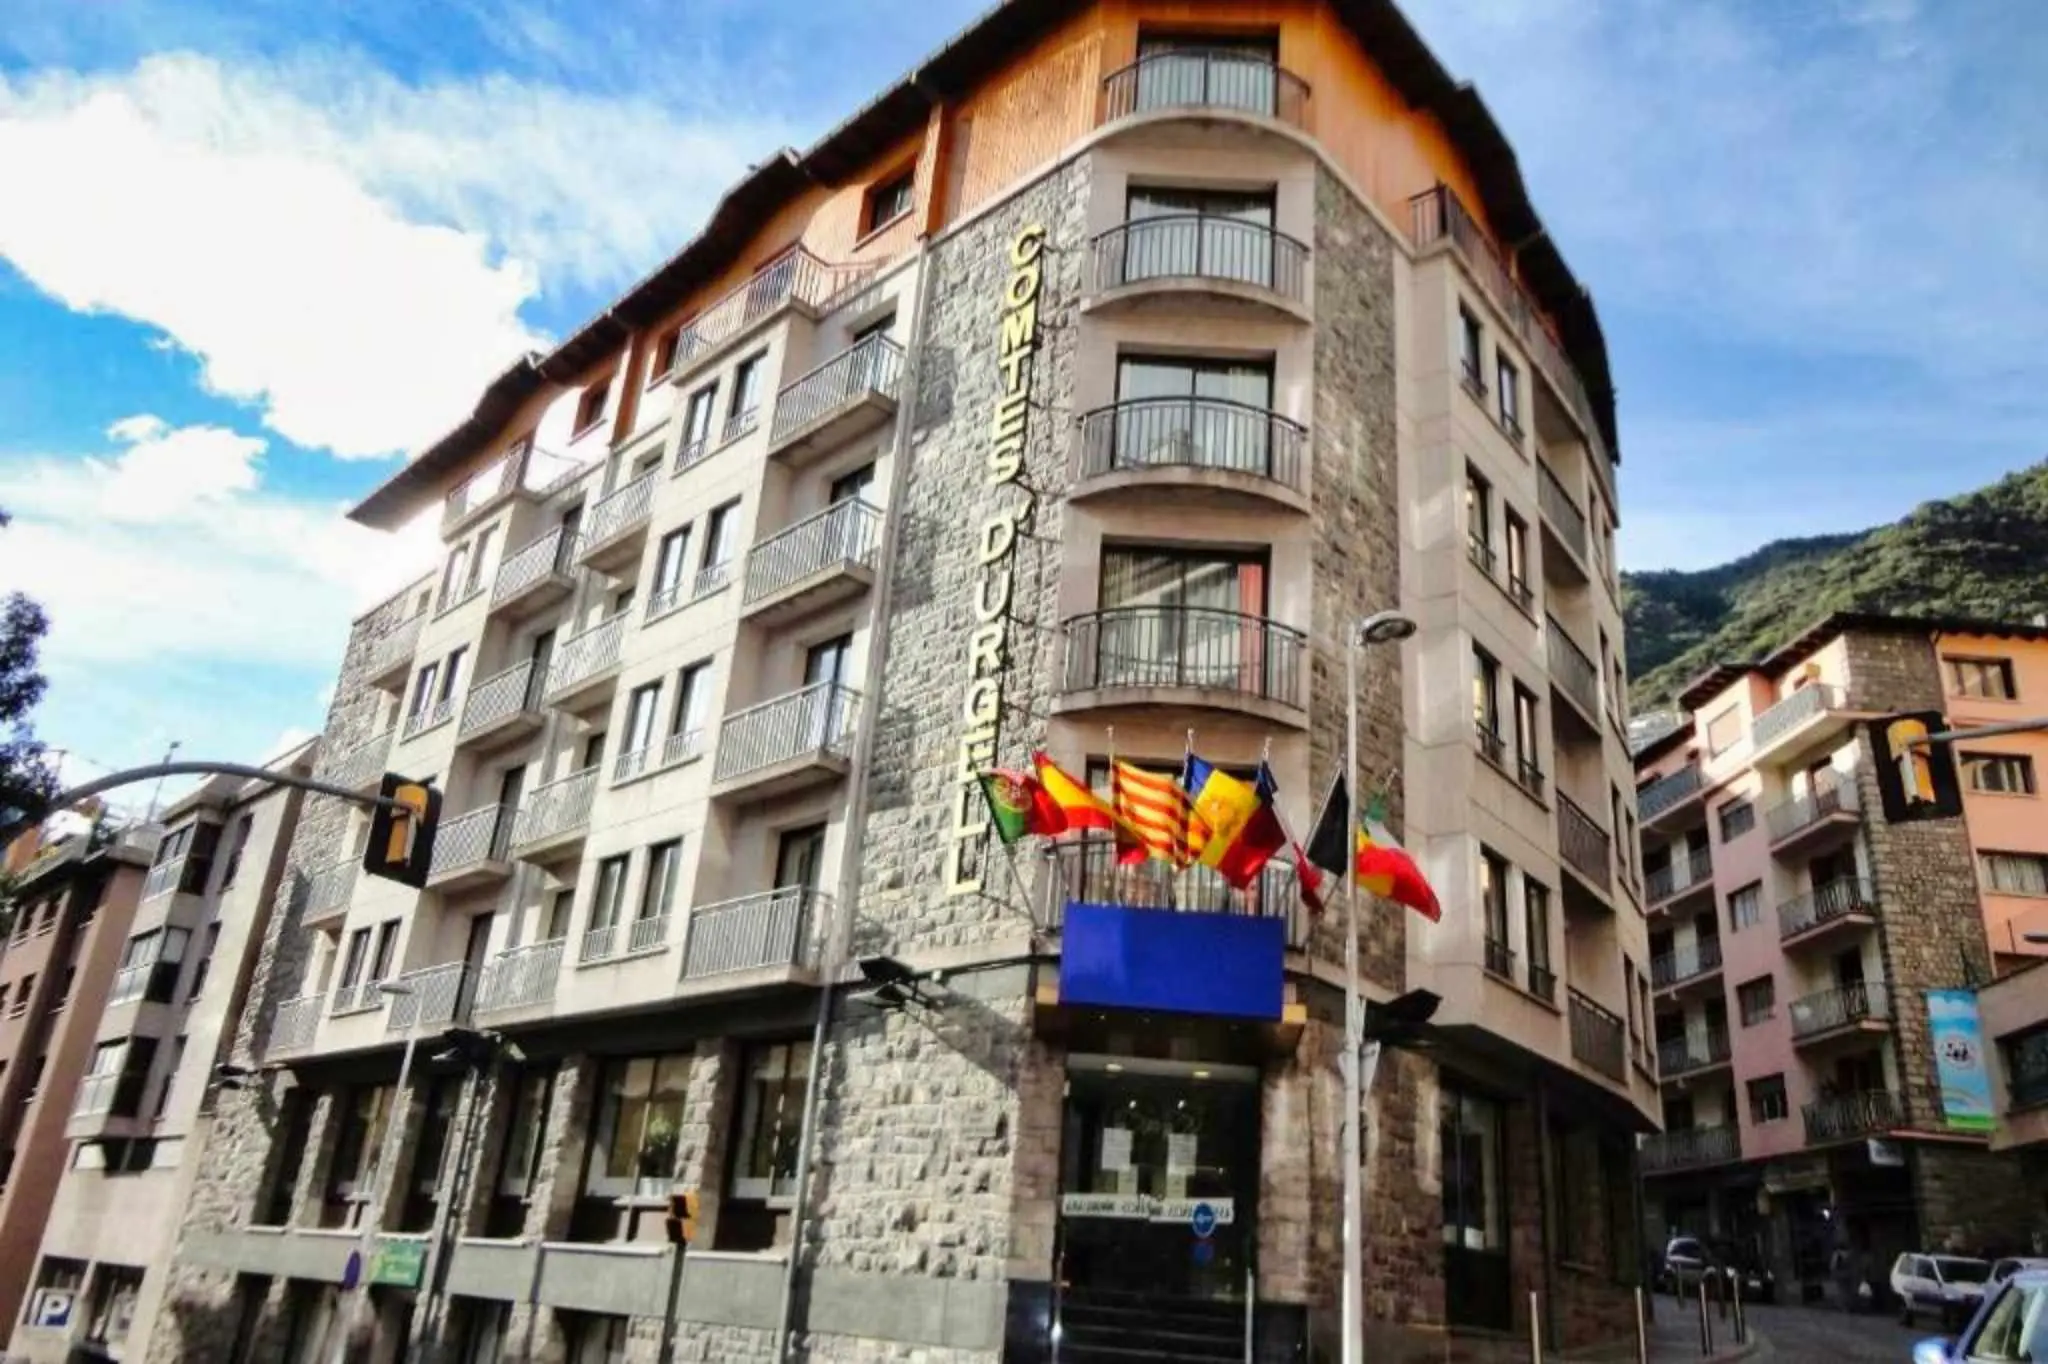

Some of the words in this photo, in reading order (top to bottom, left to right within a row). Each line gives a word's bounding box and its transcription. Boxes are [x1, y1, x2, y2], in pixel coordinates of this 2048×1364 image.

[987, 223, 1046, 485] COMTES
[946, 499, 1036, 896] D'URGELL
[38, 1294, 70, 1326] P
